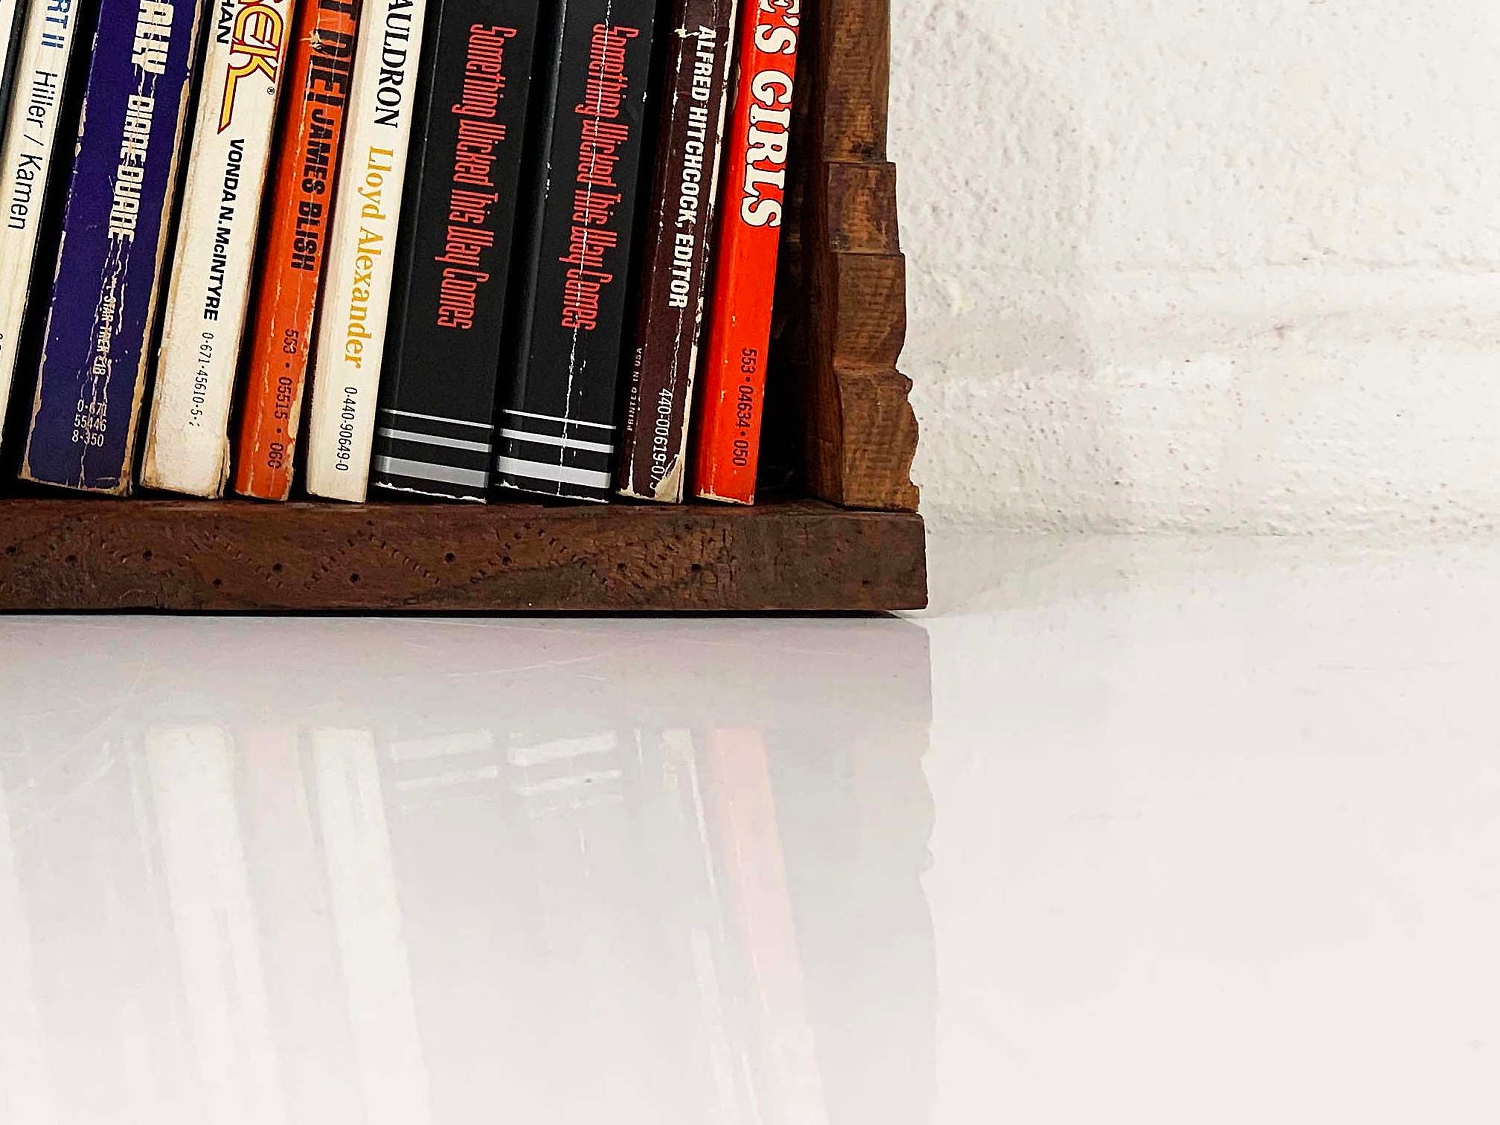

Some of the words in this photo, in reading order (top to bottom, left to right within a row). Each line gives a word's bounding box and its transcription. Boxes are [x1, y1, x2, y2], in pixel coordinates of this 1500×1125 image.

[40, 32, 65, 49] II
[130, 0, 174, 75] ALLY
[304, 27, 354, 110] DIE!
[452, 23, 518, 119] Something
[575, 23, 640, 119] Something
[691, 25, 716, 102] ALFRED
[26, 69, 58, 129] Hiller
[120, 94, 155, 163] DIANE
[222, 139, 244, 203] VONDA
[302, 108, 336, 196] JAMES
[358, 145, 394, 221] Lloyd
[453, 119, 506, 187] Wicked
[576, 119, 630, 188] Wicked
[676, 105, 709, 228] HITCHCOCK,
[741, 70, 794, 228] GIRLS
[8, 153, 43, 231] Kamen
[108, 165, 144, 242] DUANE
[450, 189, 499, 225] This
[572, 189, 622, 225] This
[290, 201, 323, 272] BLISH
[434, 225, 495, 268] Way
[558, 225, 618, 268] Way
[668, 230, 695, 309] EDITOR
[204, 225, 232, 322] McINTYRE
[344, 225, 384, 369] Alexander
[436, 267, 490, 331] Comes
[560, 267, 614, 331] Comes
[632, 370, 640, 383] IN
[634, 347, 642, 367] USA
[71, 430, 104, 447] 8-350
[336, 386, 358, 471] 0-440-90649-0
[626, 387, 638, 431] PRINTED
